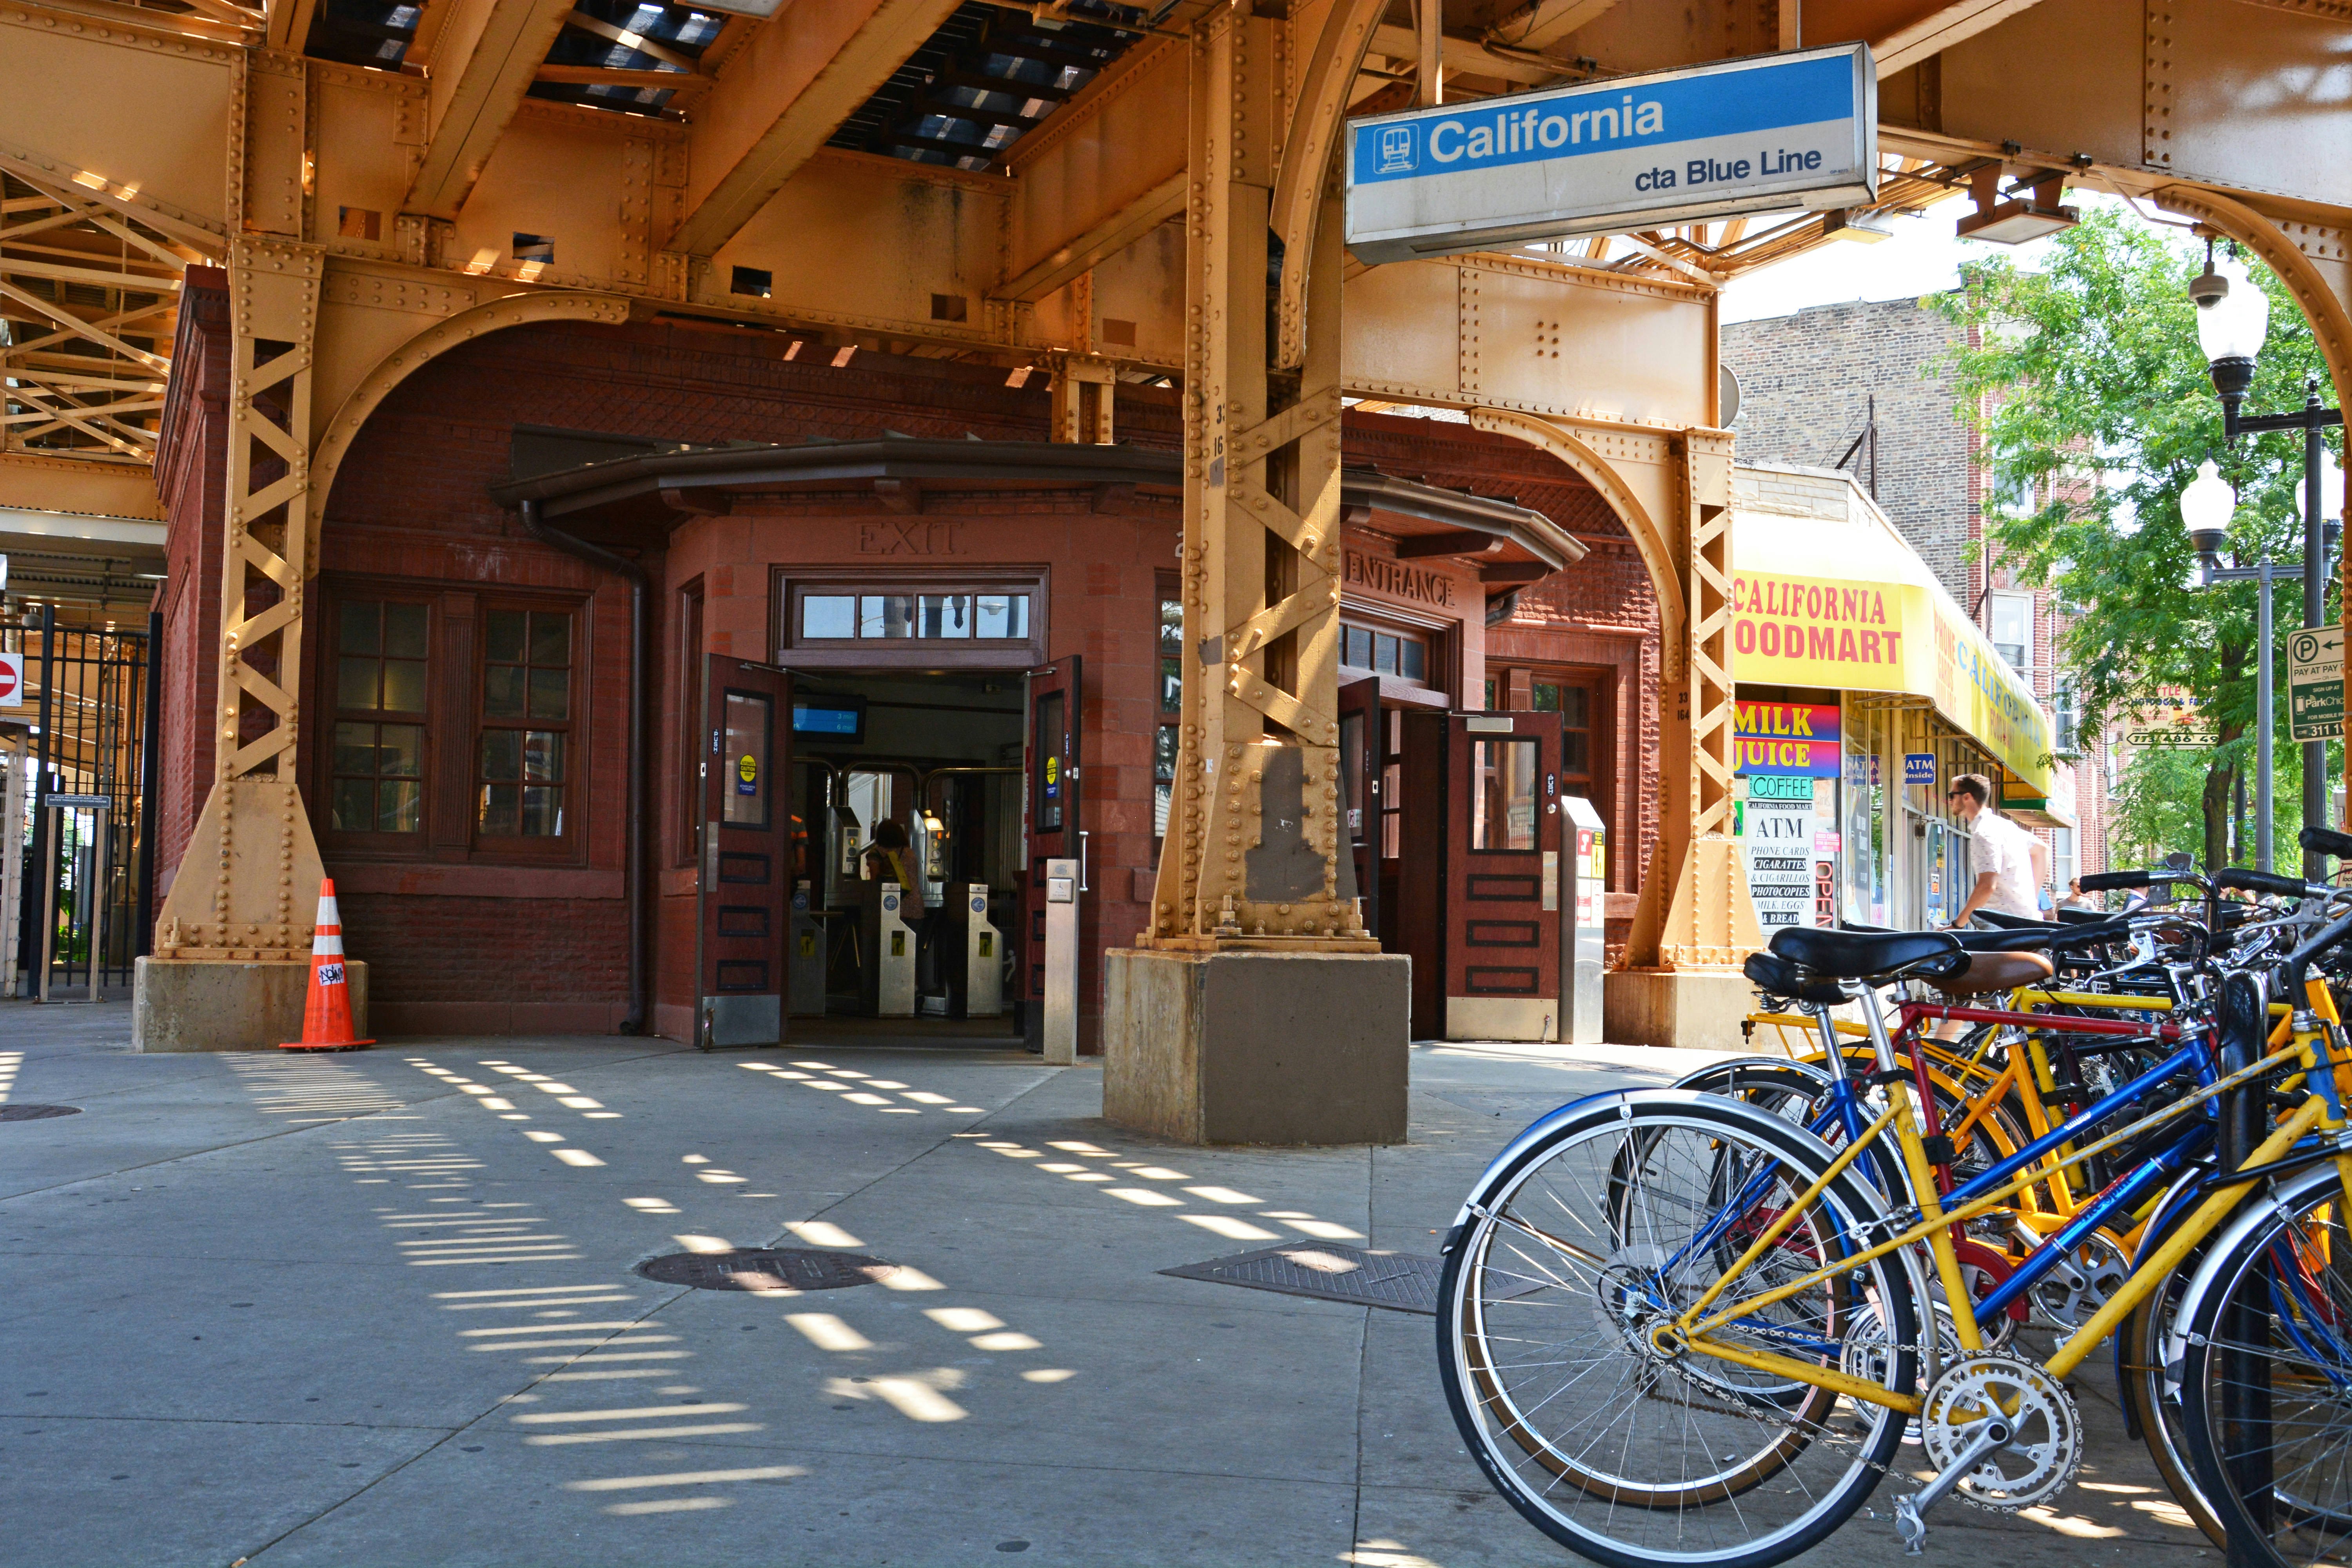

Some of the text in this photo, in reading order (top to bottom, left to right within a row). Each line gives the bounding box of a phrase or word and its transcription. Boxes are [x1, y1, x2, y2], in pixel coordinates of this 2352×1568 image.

[1429, 95, 1664, 163] California
[1635, 149, 1822, 191] cta Blue Line
[1214, 435, 1223, 457] 16
[1346, 552, 1455, 608] ENTRANCE
[1733, 578, 1886, 624] CALIFORNIA
[1735, 619, 1901, 664] OODMART
[2300, 640, 2312, 658] P
[2294, 668, 2308, 677] PAY
[2323, 664, 2338, 673] PAY
[1958, 641, 2041, 748] CALIFORNIA
[2156, 686, 2181, 697] TTLE
[2305, 696, 2345, 708] ParkChic
[1733, 704, 1813, 736] MILK
[2311, 725, 2329, 737] 311
[1733, 740, 1810, 771] JUICE
[1906, 760, 1933, 769] ATM
[1753, 777, 1808, 797] COFFEE
[1756, 818, 1804, 838] ATM
[1751, 846, 1810, 855] PHONE CARDS
[1754, 860, 1806, 869] CIGARATTES
[1751, 873, 1810, 882] & CIGARILLOS
[1751, 887, 1810, 897] PHOTOCOPIES
[1815, 862, 1833, 930] OPEN
[1781, 901, 1805, 910] EGGS
[1762, 914, 1799, 924] & BREAD
